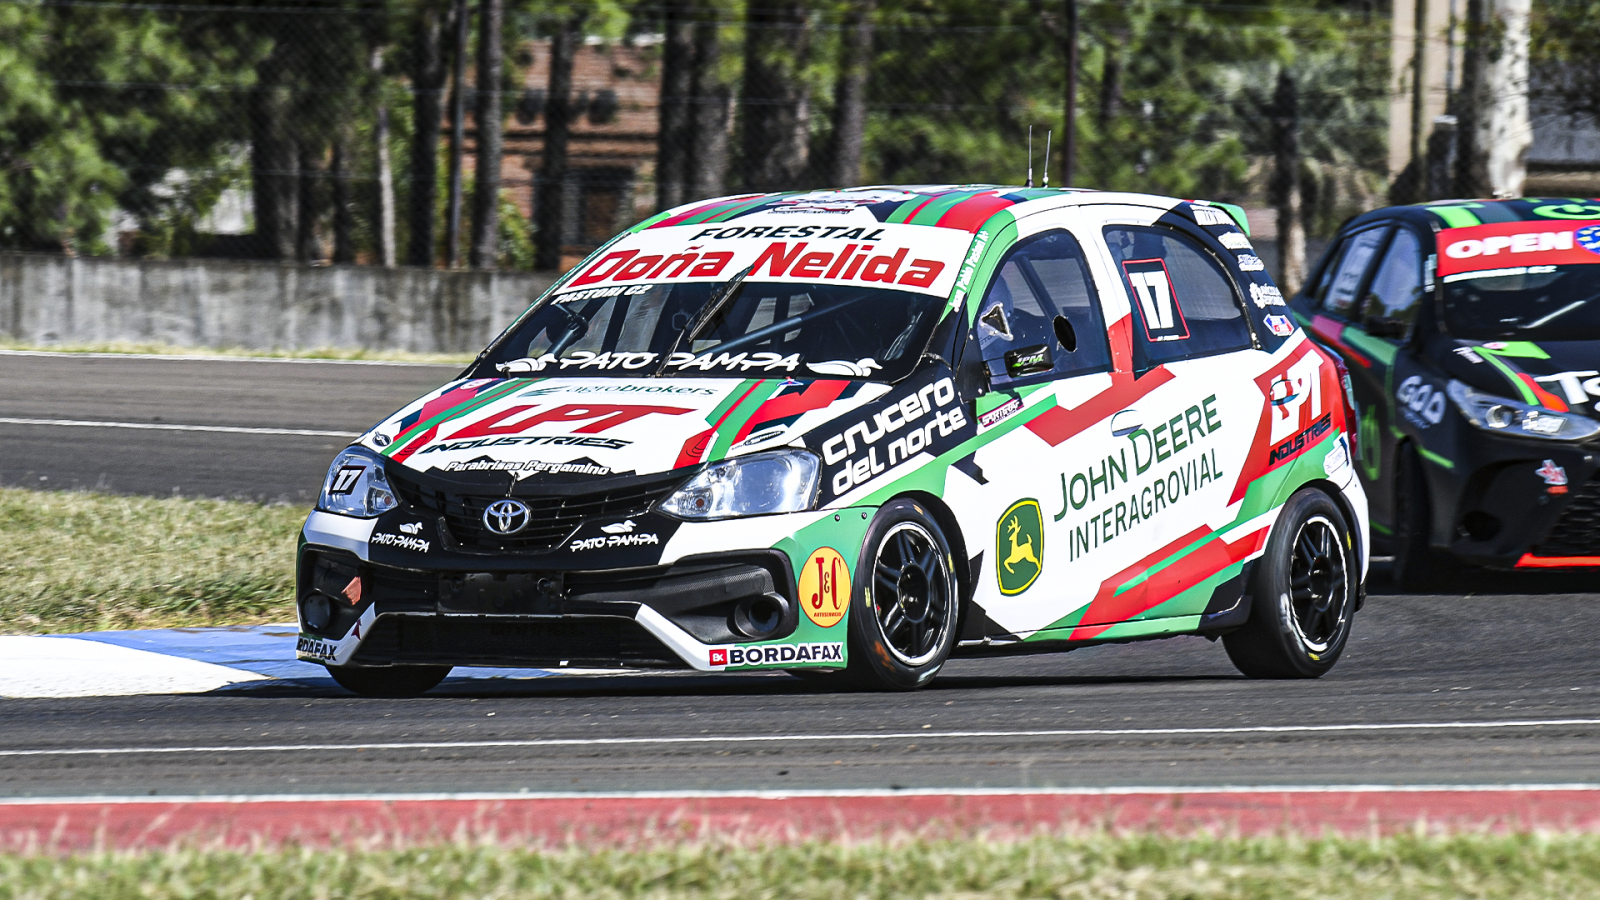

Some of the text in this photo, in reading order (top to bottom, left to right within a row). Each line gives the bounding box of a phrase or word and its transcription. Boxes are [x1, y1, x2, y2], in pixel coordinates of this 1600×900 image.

[689, 226, 885, 241] FORESTAL
[1446, 231, 1573, 258] OPEN
[567, 242, 945, 288] Doña Nelida
[956, 266, 974, 290] Pablo
[551, 284, 653, 305] PASTORI C2
[1129, 270, 1174, 329] 17
[559, 351, 800, 371] PATO PAMPA
[566, 384, 718, 396] agrobrokers
[441, 404, 698, 442] LPT
[822, 377, 954, 465] crucero
[418, 436, 634, 454] INDUSTRIES
[1269, 411, 1331, 466] INDUSTRIES
[833, 406, 967, 495] del norte
[1053, 394, 1222, 522] JOHN DEERE
[445, 460, 611, 475] Parabrisas Pergamino
[332, 469, 363, 491] 17
[1069, 448, 1223, 562] INTERAGROVIAL
[371, 532, 430, 553] PATO PAMPA
[570, 533, 659, 552] PATO PAMPA
[730, 644, 842, 664] BORDAFAX
